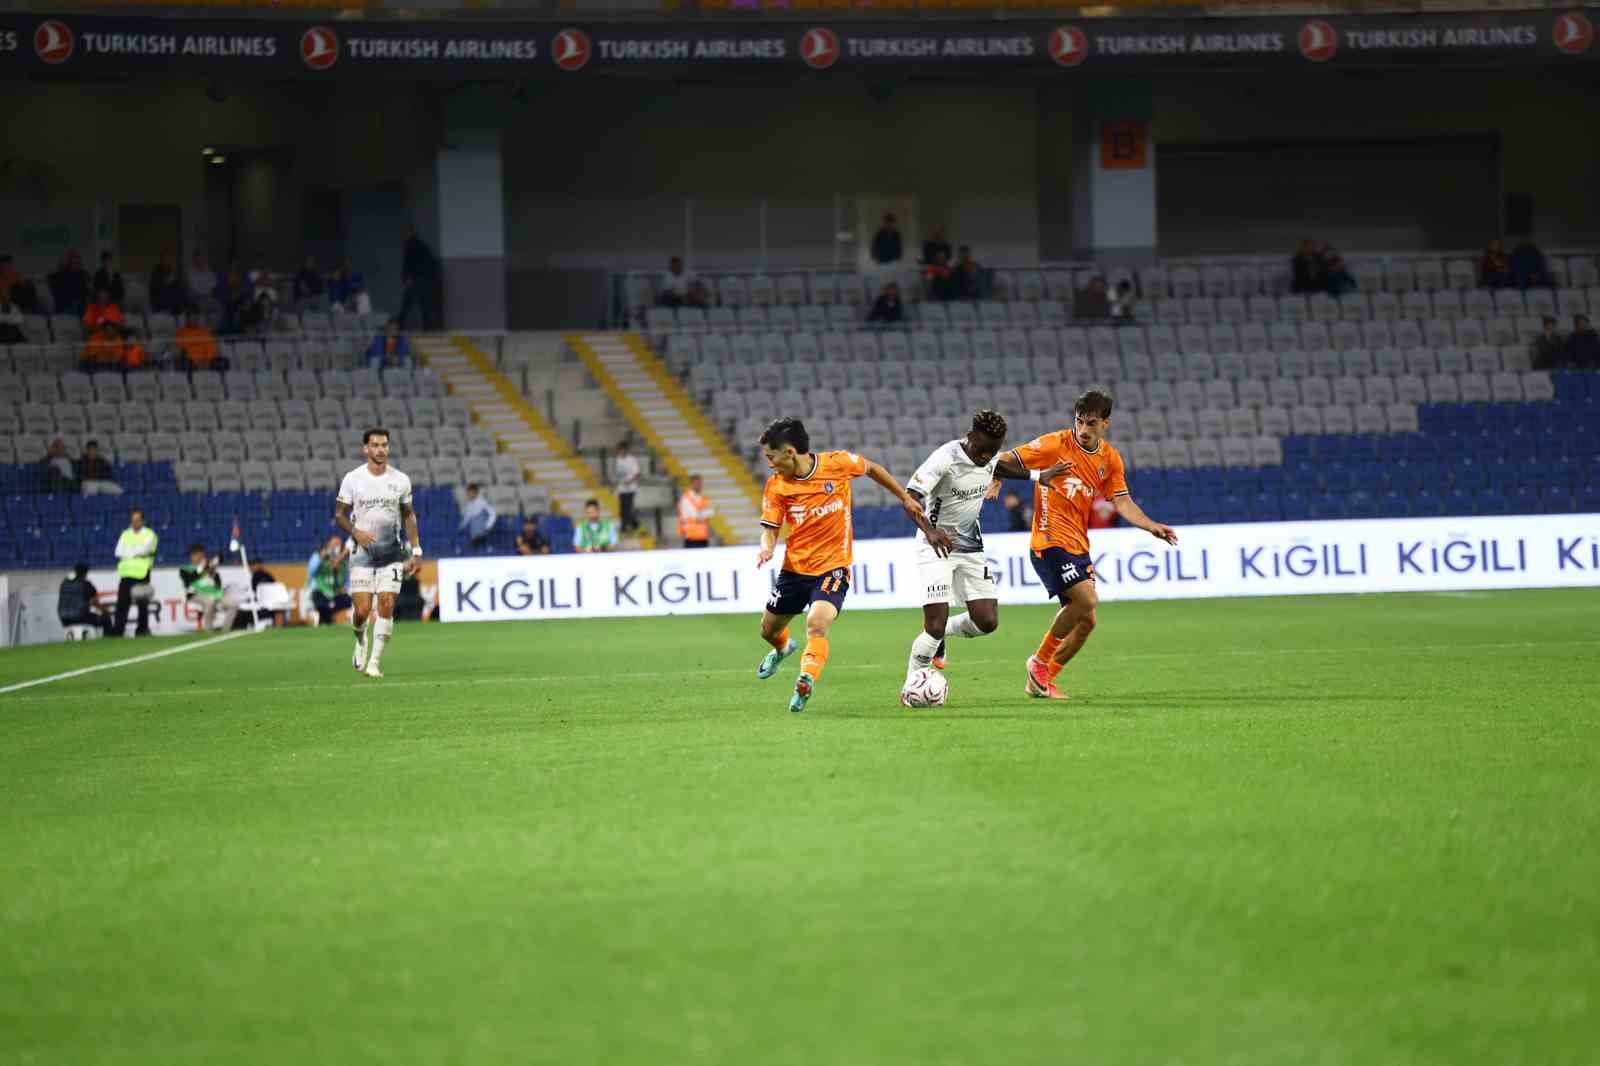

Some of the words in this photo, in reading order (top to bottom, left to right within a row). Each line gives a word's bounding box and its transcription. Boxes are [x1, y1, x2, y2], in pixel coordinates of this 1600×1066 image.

[82, 34, 175, 54] TURKISH
[182, 36, 277, 57] AIRLINES
[347, 38, 440, 59] TURKISH
[443, 39, 538, 59] AIRLINES
[846, 38, 938, 57] TURKISH
[942, 37, 1035, 56] AIRLINES
[1095, 35, 1186, 55] TURKISH
[1190, 33, 1284, 52] AIRLINES
[1345, 30, 1438, 50] TURKISH
[1443, 26, 1538, 46] AIRLINES
[598, 39, 690, 59] TURKISH
[694, 39, 787, 58] AIRLINES
